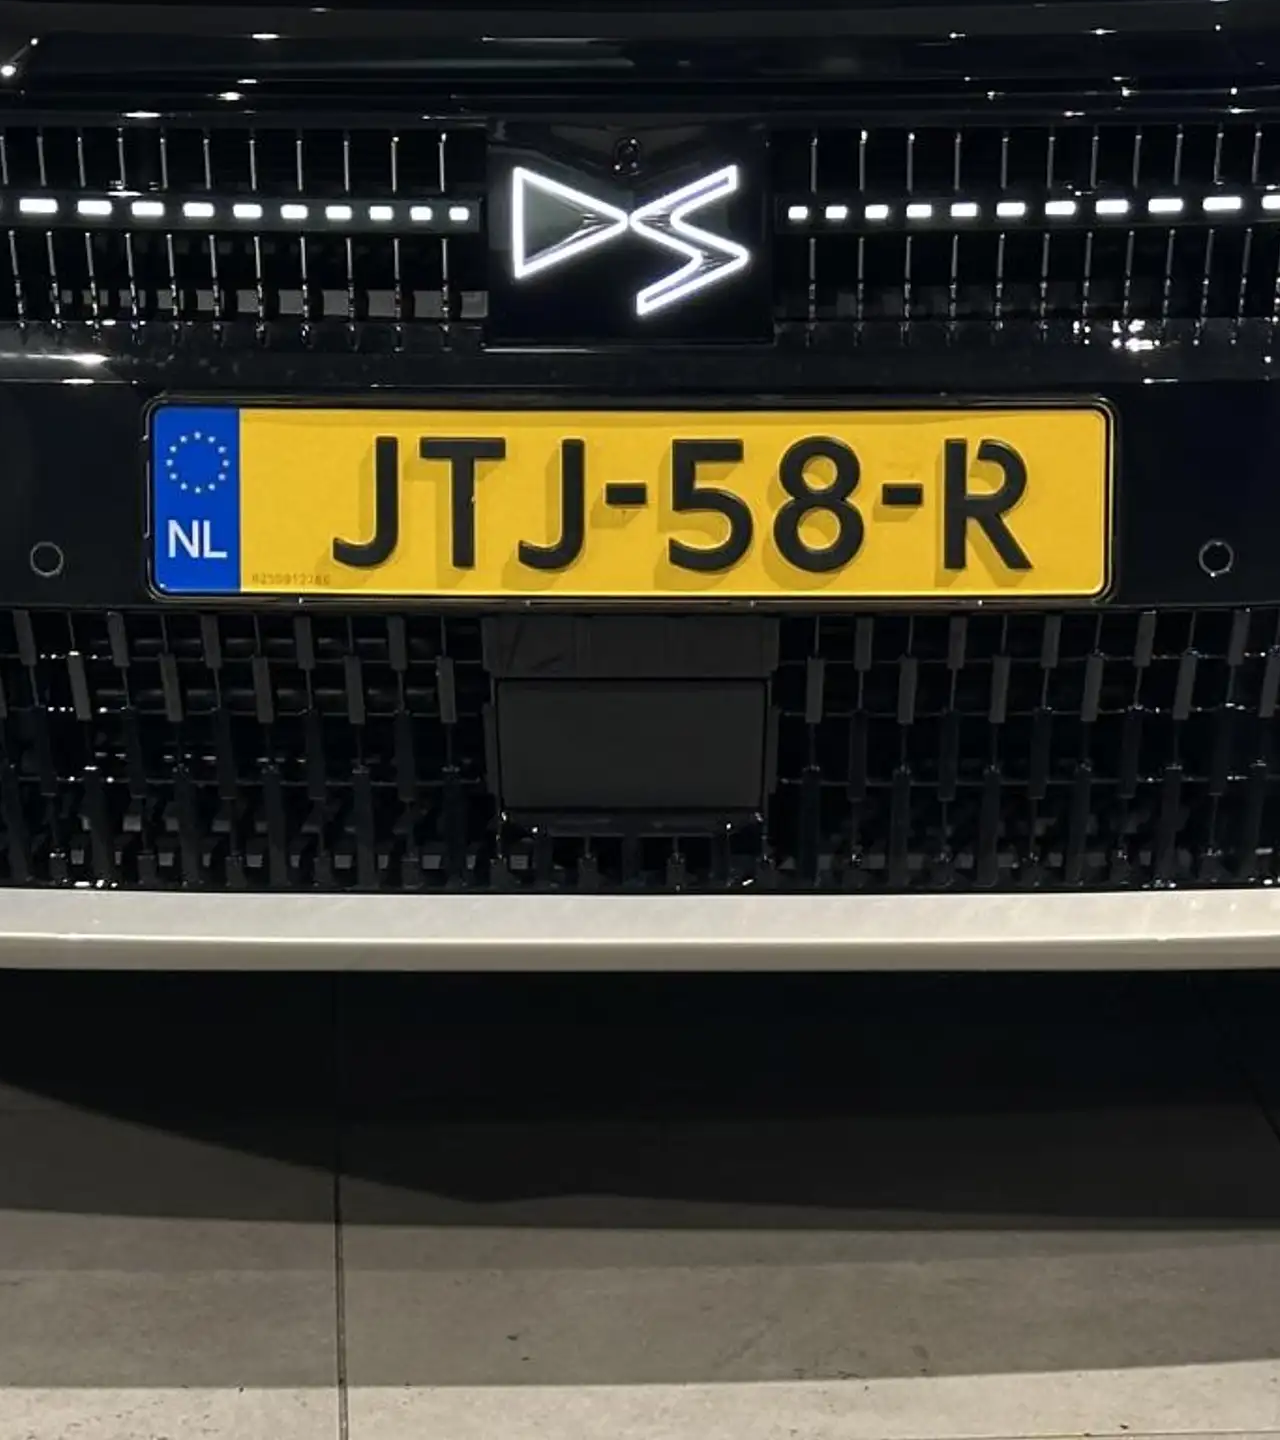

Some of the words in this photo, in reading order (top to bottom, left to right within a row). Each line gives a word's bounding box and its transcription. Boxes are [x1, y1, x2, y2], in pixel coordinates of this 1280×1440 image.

[512, 164, 750, 317] DS
[167, 519, 229, 559] NL
[332, 435, 1034, 573] JTJ-58-R
